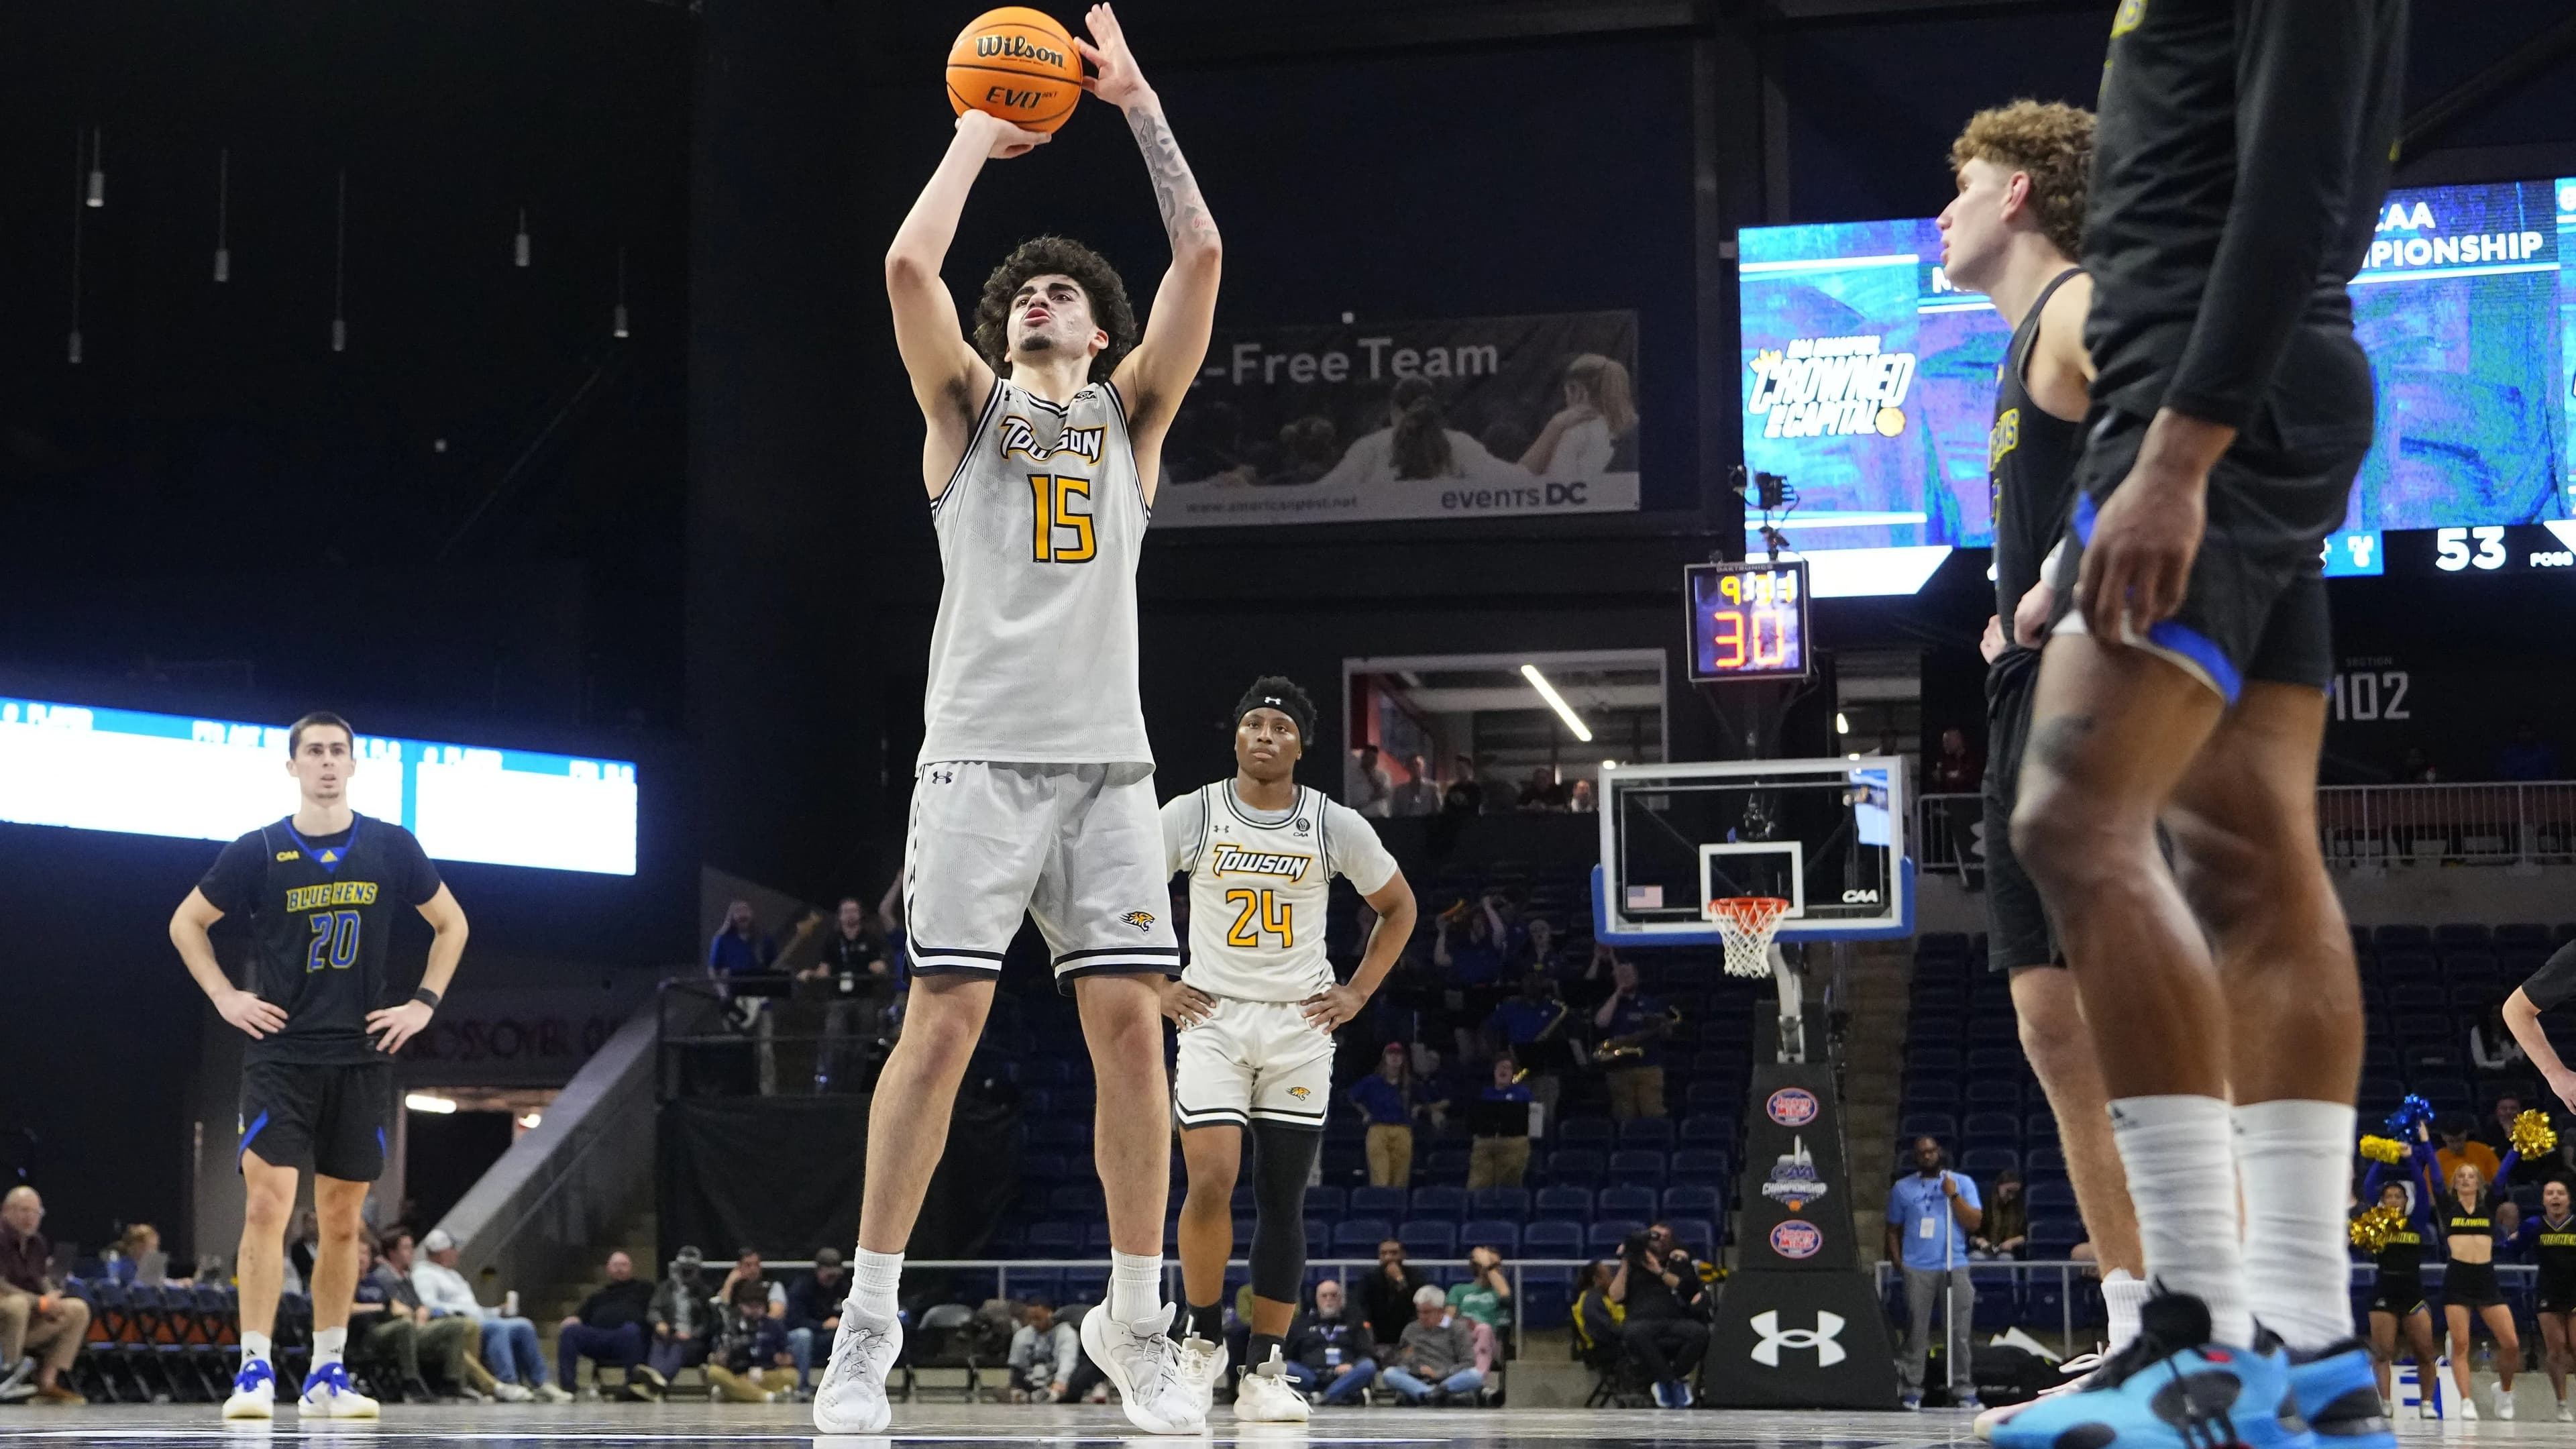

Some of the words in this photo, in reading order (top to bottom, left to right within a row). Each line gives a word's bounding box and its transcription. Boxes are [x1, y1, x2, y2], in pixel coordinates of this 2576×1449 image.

[975, 34, 1064, 68] Wilson
[986, 86, 1042, 109] EVO
[2362, 231, 2544, 268] PIONSHIP
[1195, 341, 1349, 387] -Free
[1357, 337, 1498, 380] Team
[1748, 353, 1916, 415] CROWNED
[1546, 482, 1588, 506] DC
[1027, 474, 1097, 564] 15
[2436, 526, 2506, 571] 53
[1715, 611, 1784, 667] 30
[2334, 672, 2410, 721] 102
[276, 850, 300, 862] CAA
[1213, 843, 1313, 883] TOWSON
[1842, 890, 1878, 903] CAA
[1226, 888, 1294, 949] 24
[306, 910, 361, 973] 20
[1762, 1182, 1827, 1196] CHAMPIONSHIP
